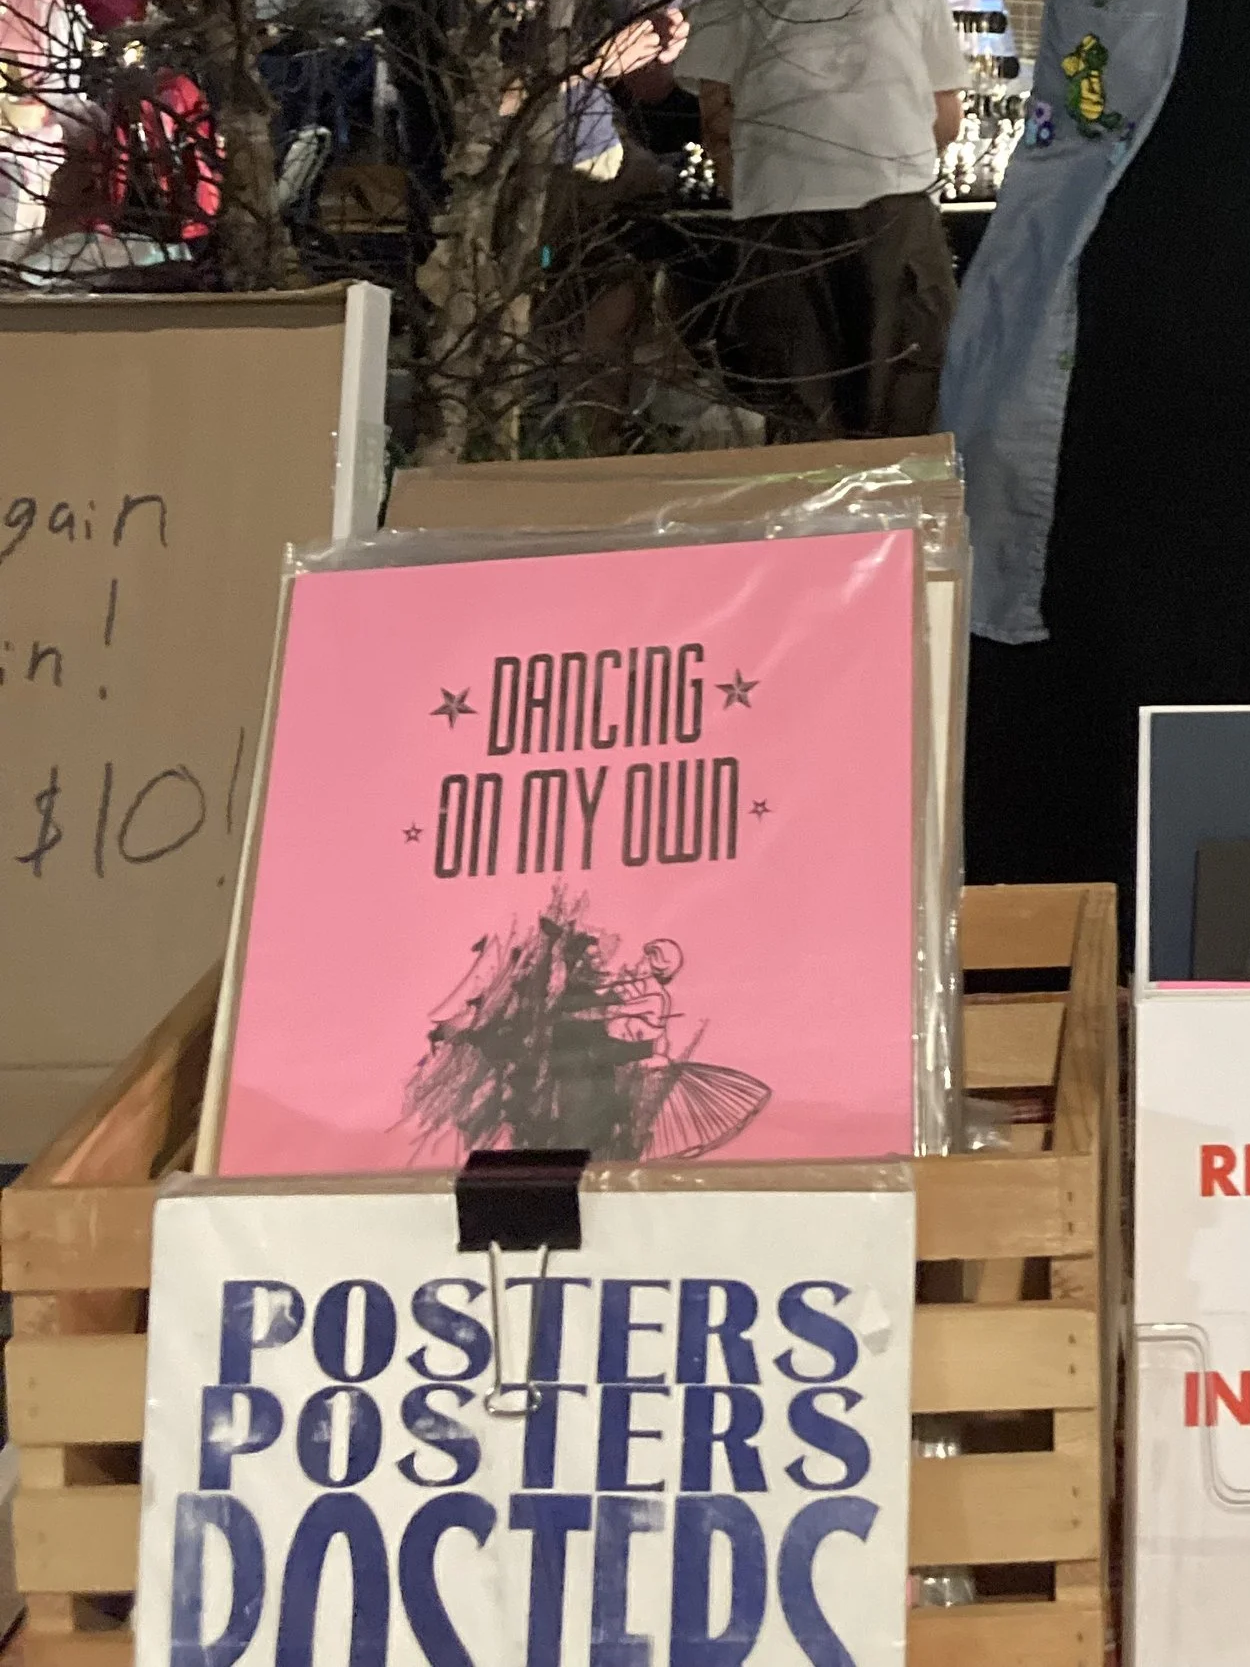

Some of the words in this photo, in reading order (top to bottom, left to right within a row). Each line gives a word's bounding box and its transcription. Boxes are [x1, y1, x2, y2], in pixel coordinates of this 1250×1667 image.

[487, 643, 705, 757] DANCING
[433, 772, 503, 880] ON
[516, 765, 608, 875] MY
[621, 755, 740, 868] OWN
[218, 1277, 861, 1386] POSTERS
[200, 1383, 872, 1494] POSTERS
